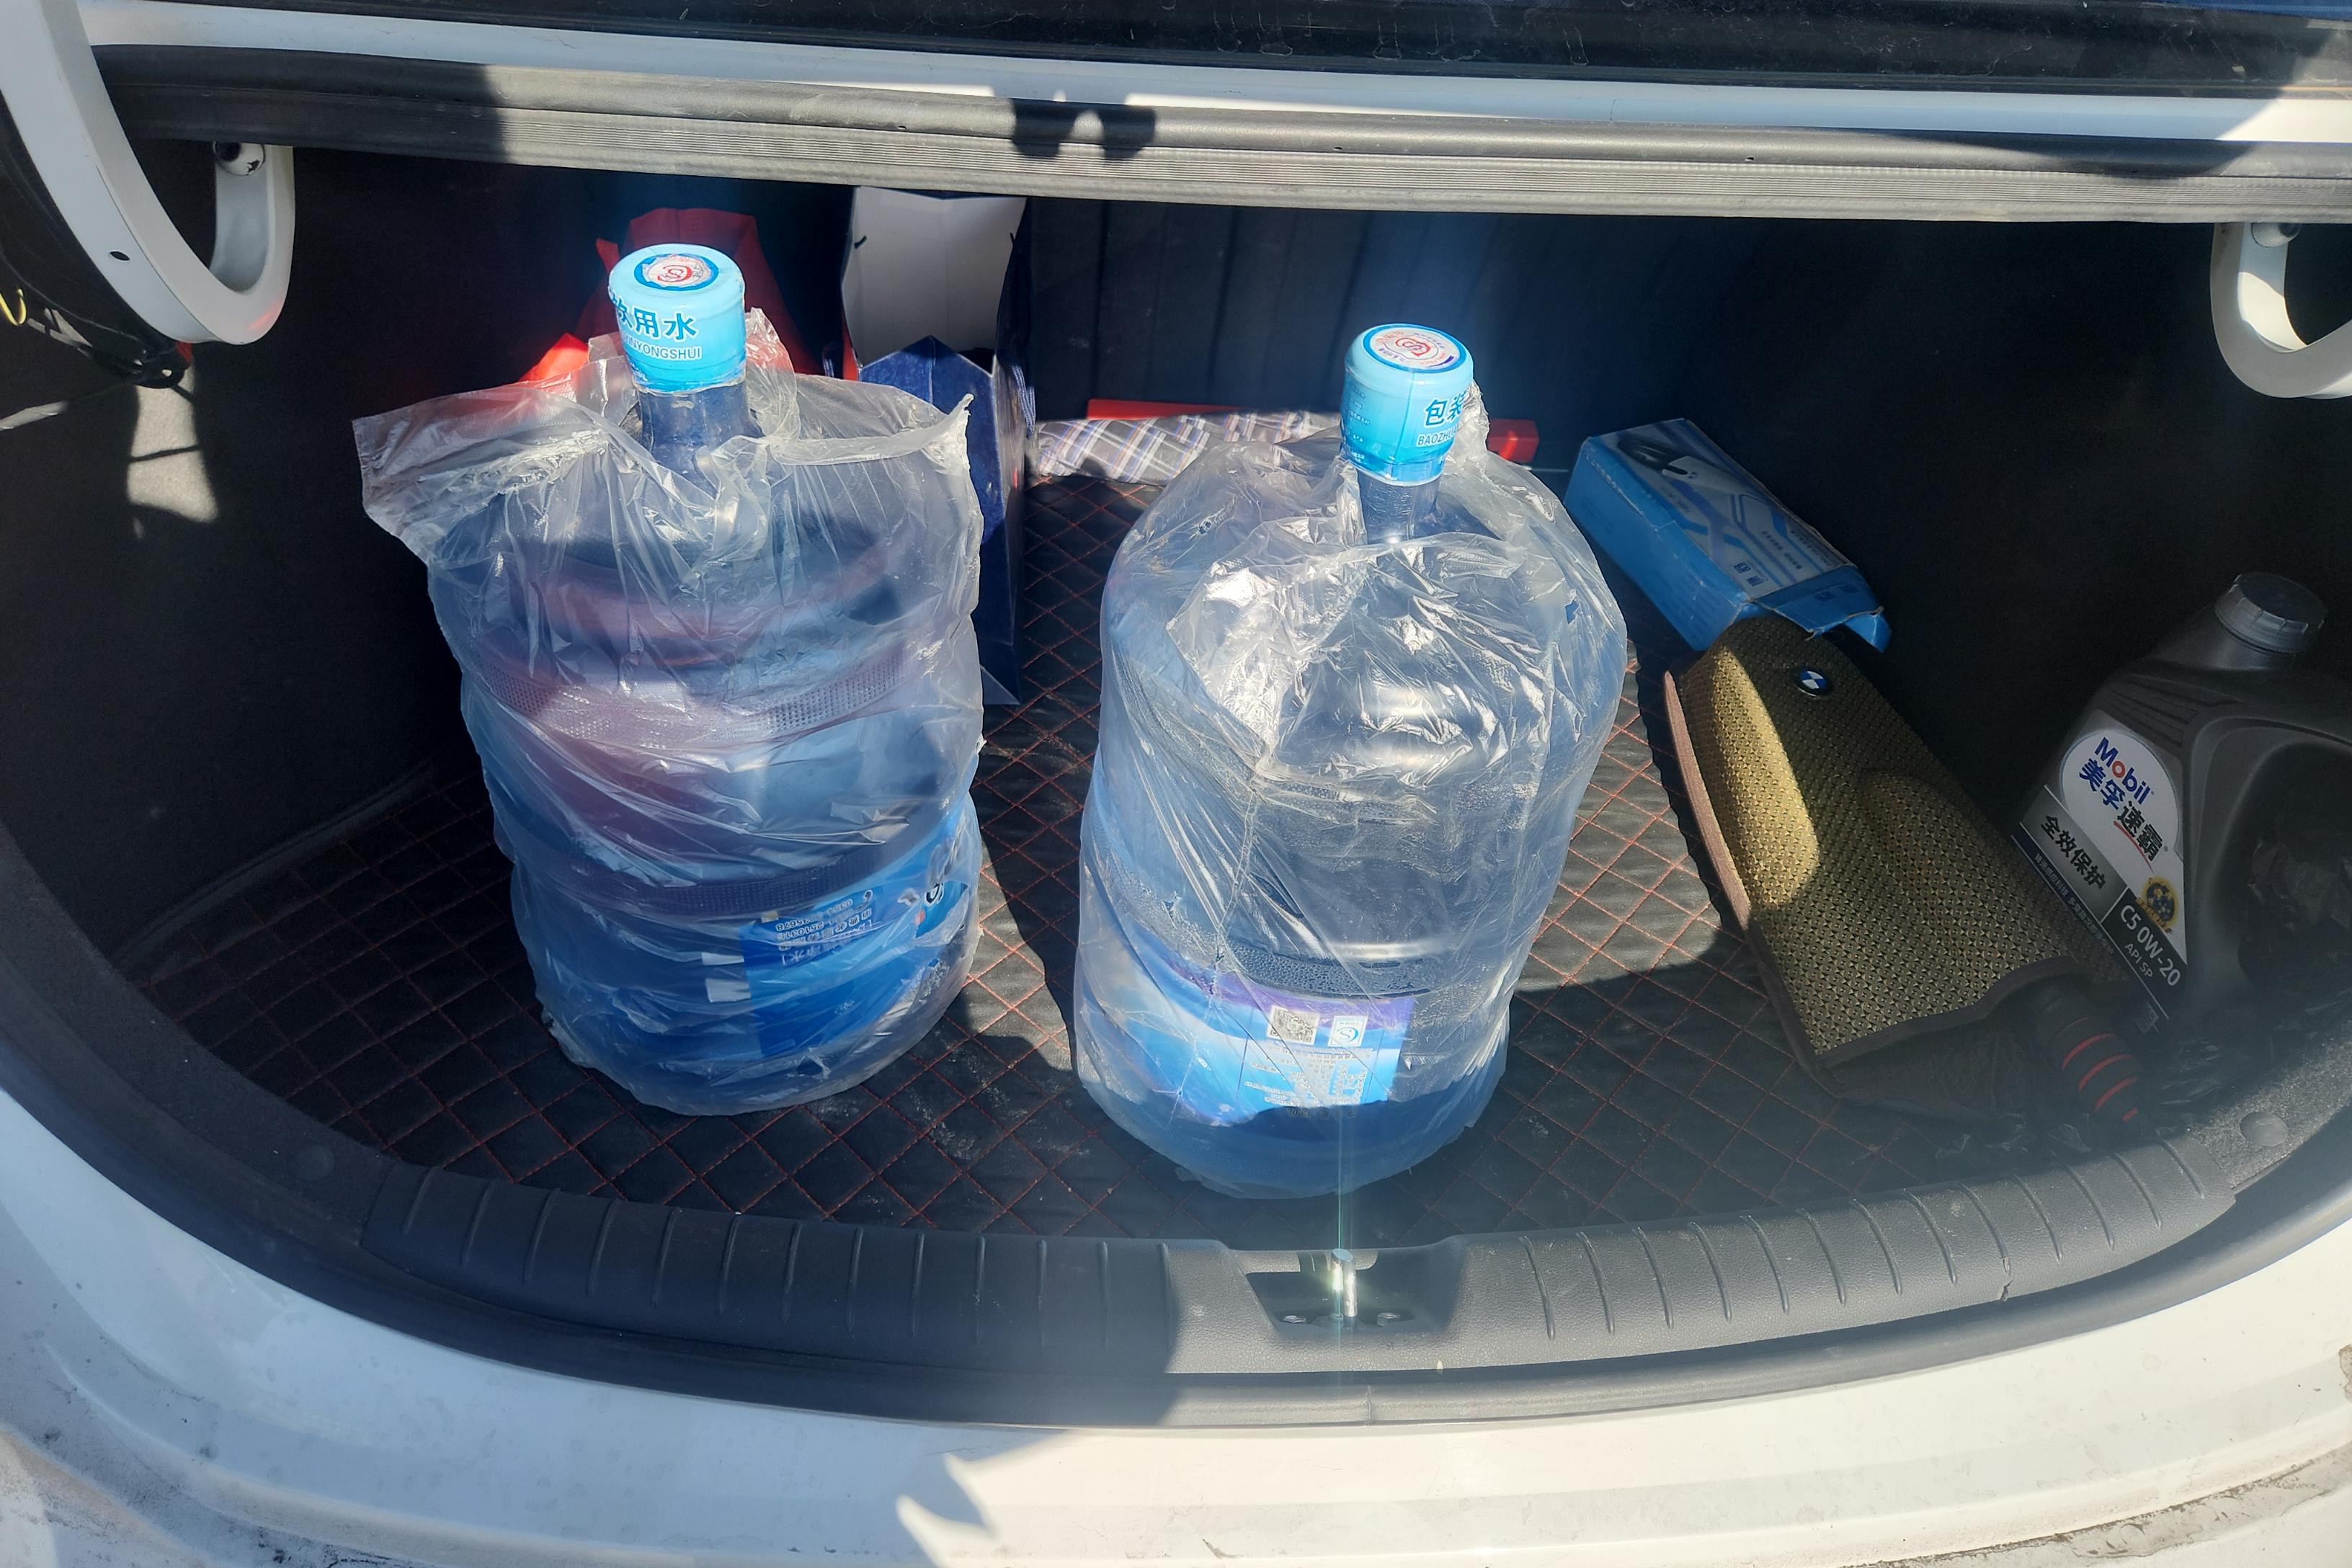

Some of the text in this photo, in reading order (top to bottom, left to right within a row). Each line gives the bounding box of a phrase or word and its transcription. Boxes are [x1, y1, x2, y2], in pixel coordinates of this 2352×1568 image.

[2095, 737, 2151, 805] Mobil
[2079, 758, 2162, 861] 美孚速霸
[2041, 815, 2106, 889] 全效保护
[2121, 904, 2142, 930] C5
[2137, 926, 2181, 986] 0W-20
[2125, 943, 2154, 979] API SP
